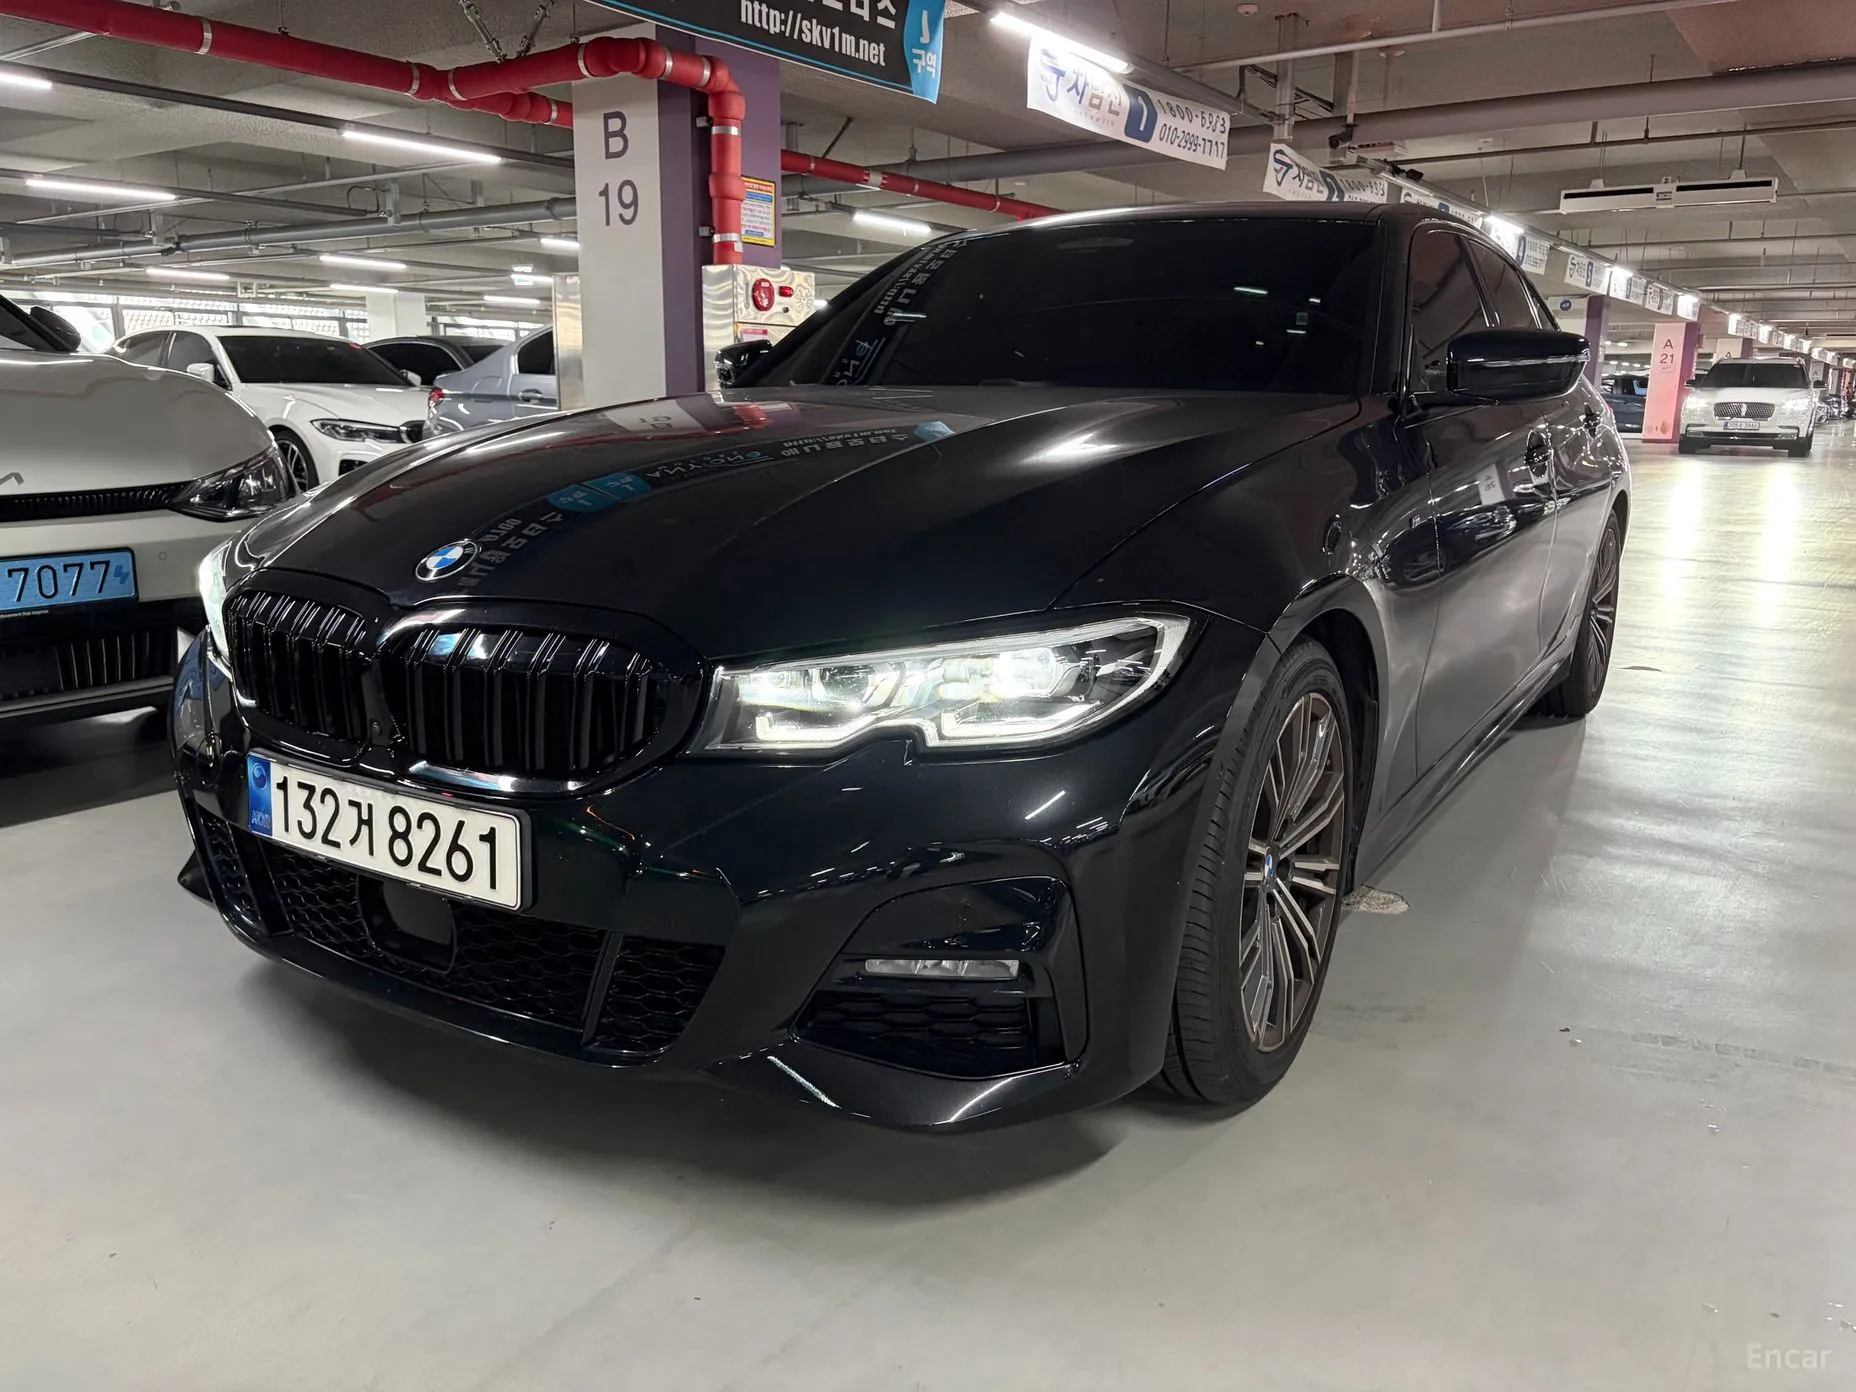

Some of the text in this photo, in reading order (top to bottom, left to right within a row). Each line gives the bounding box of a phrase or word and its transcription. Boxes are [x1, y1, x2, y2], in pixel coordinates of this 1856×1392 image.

[740, 0, 886, 67] http://skv1m.net
[911, 48, 937, 79] 구역
[602, 110, 629, 160] B
[1157, 99, 1227, 134] 1800-6983
[1158, 123, 1225, 160] 010-2999-7717
[598, 179, 639, 227] 19
[1659, 353, 1675, 364] 21
[1663, 338, 1674, 350] A
[7, 559, 111, 602] 7077
[388, 804, 498, 890] 8261
